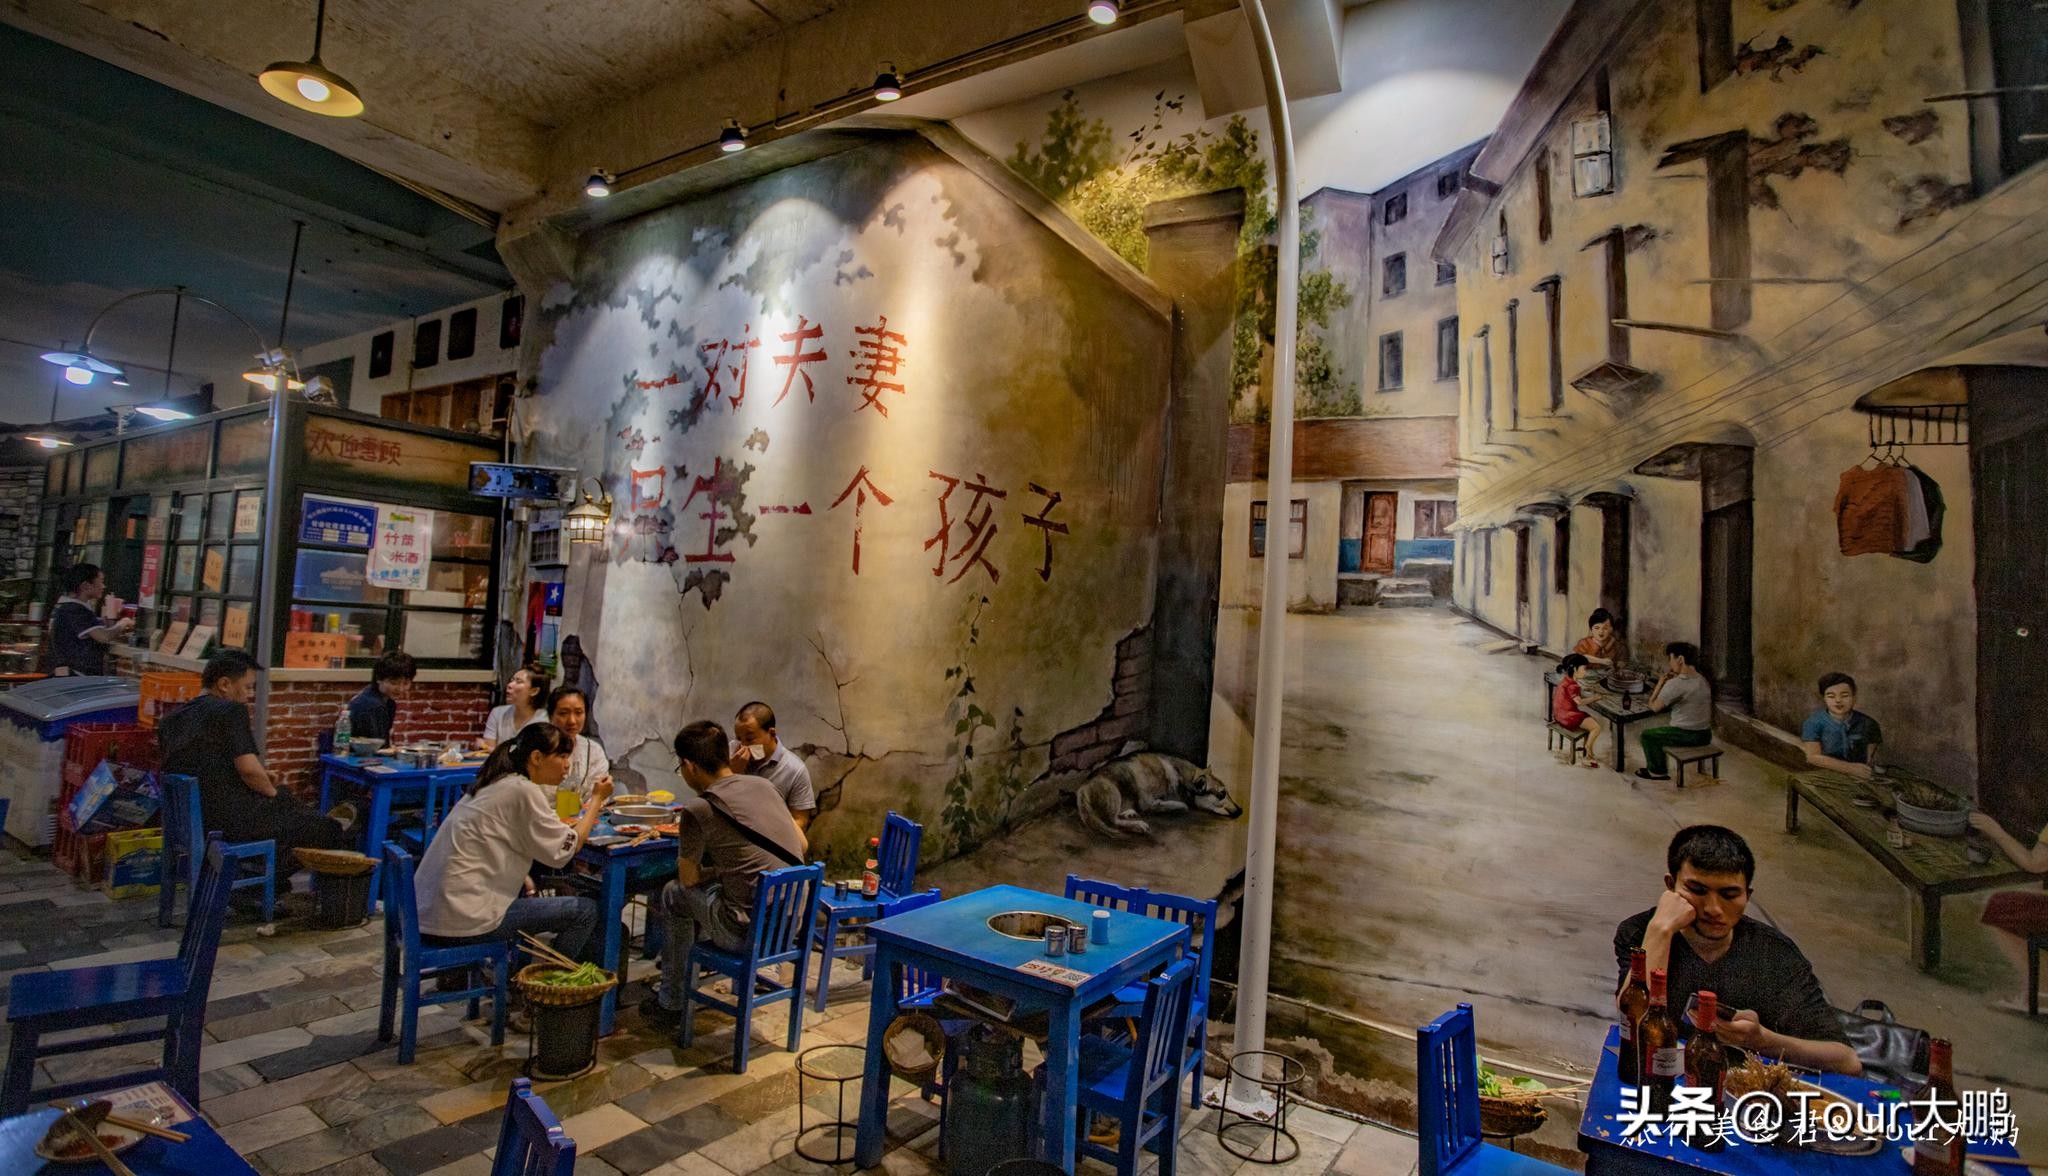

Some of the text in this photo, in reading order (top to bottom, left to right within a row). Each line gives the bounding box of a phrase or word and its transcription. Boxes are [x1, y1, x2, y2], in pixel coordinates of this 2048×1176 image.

[635, 314, 908, 420] 一对夫妻
[309, 429, 402, 466] 欢迎惠顾
[619, 456, 1070, 585] 只生一个孩子
